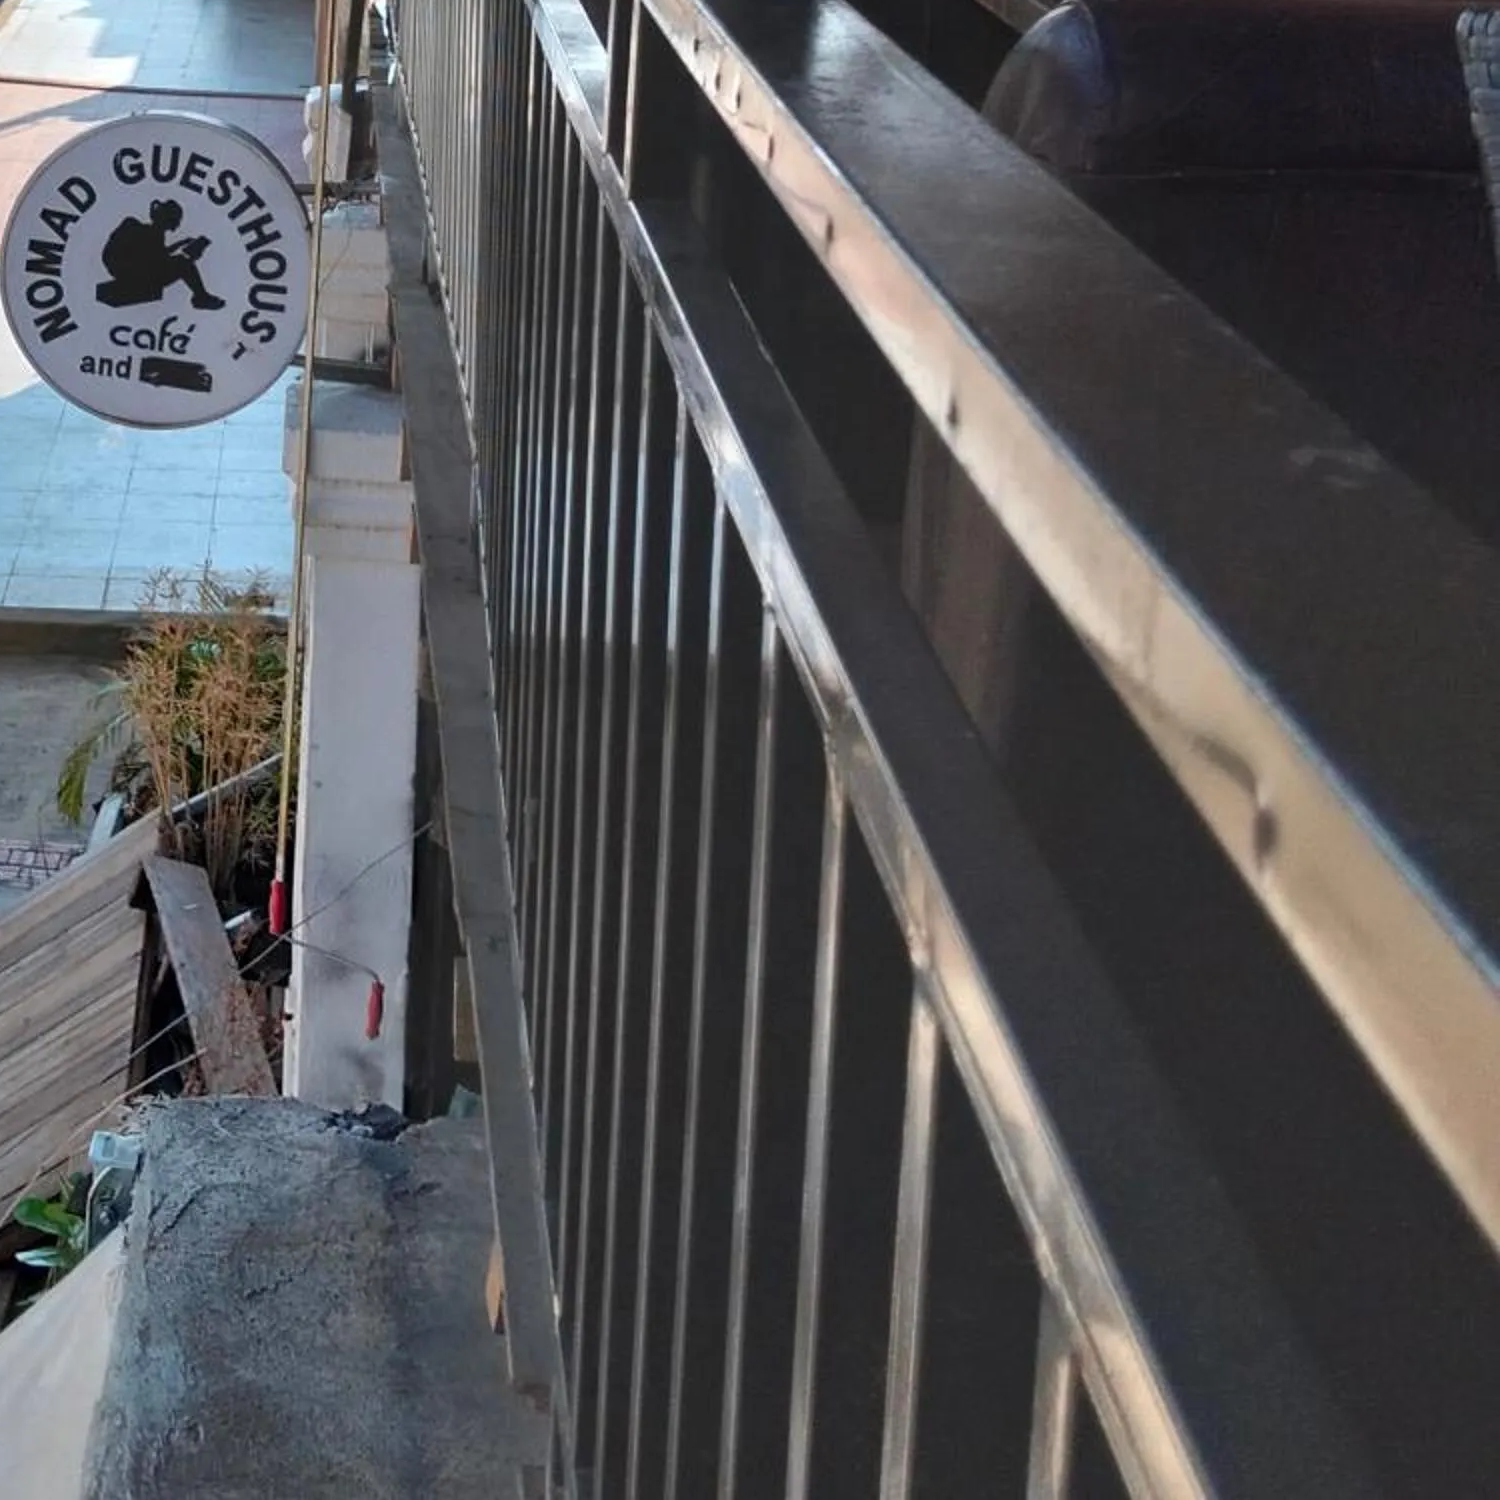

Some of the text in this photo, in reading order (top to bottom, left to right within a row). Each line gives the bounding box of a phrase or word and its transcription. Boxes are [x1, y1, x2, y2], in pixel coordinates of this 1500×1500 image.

[25, 176, 97, 344] NOMAD
[108, 315, 196, 355] café
[79, 355, 133, 380] and
